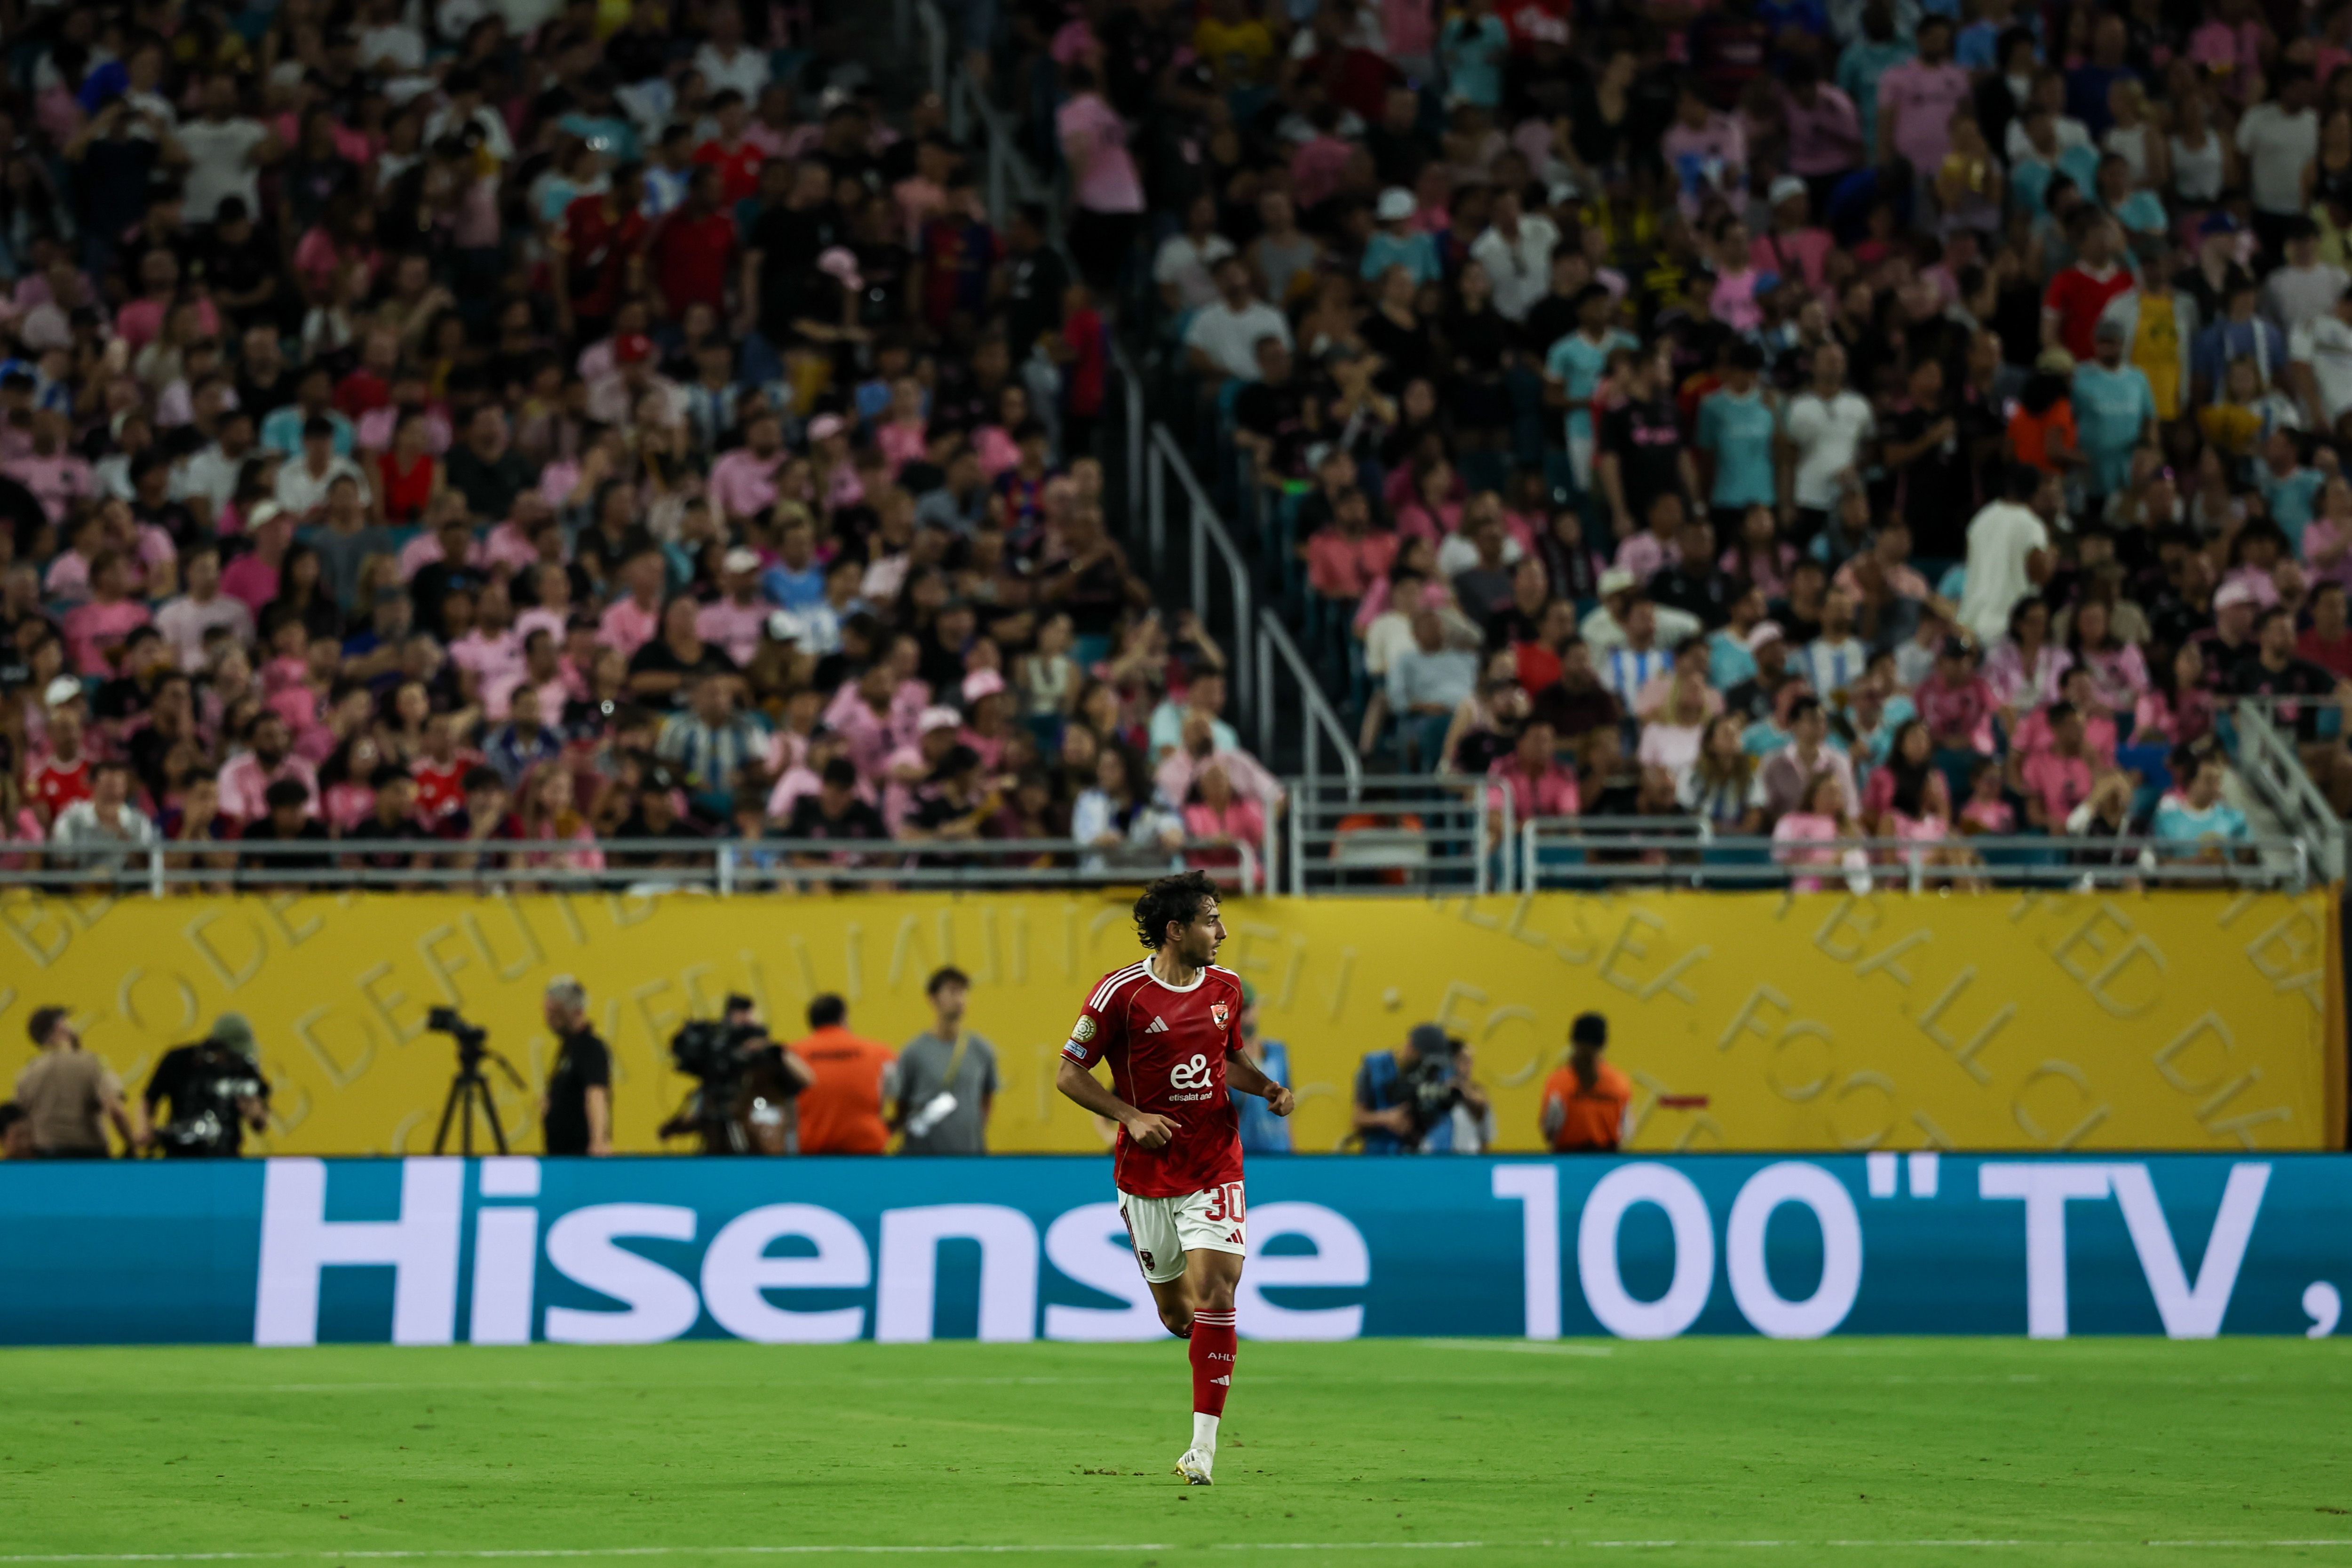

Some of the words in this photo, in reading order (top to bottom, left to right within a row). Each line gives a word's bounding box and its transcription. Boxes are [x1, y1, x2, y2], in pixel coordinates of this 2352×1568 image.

[1169, 1093, 1199, 1101] etisalat
[1200, 1090, 1213, 1100] and
[1203, 1184, 1245, 1223] 30
[254, 1157, 1370, 1347] Hisense
[1208, 1352, 1236, 1362] AHLY
